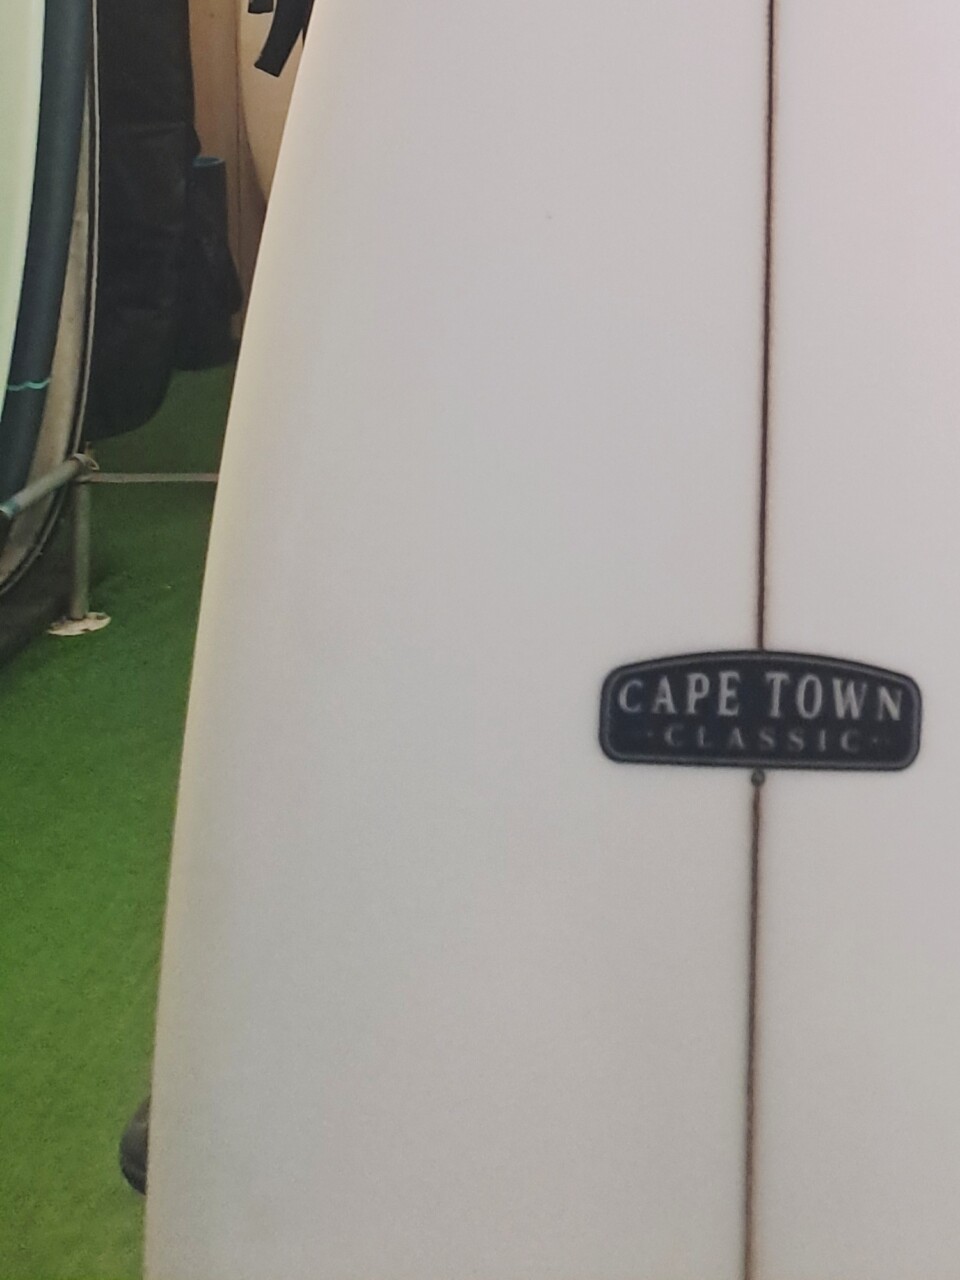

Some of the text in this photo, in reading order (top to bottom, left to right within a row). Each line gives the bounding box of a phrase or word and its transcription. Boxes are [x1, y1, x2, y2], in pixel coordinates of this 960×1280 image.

[617, 670, 902, 721] CAPE TOWN
[663, 723, 860, 754] CLASSIC
